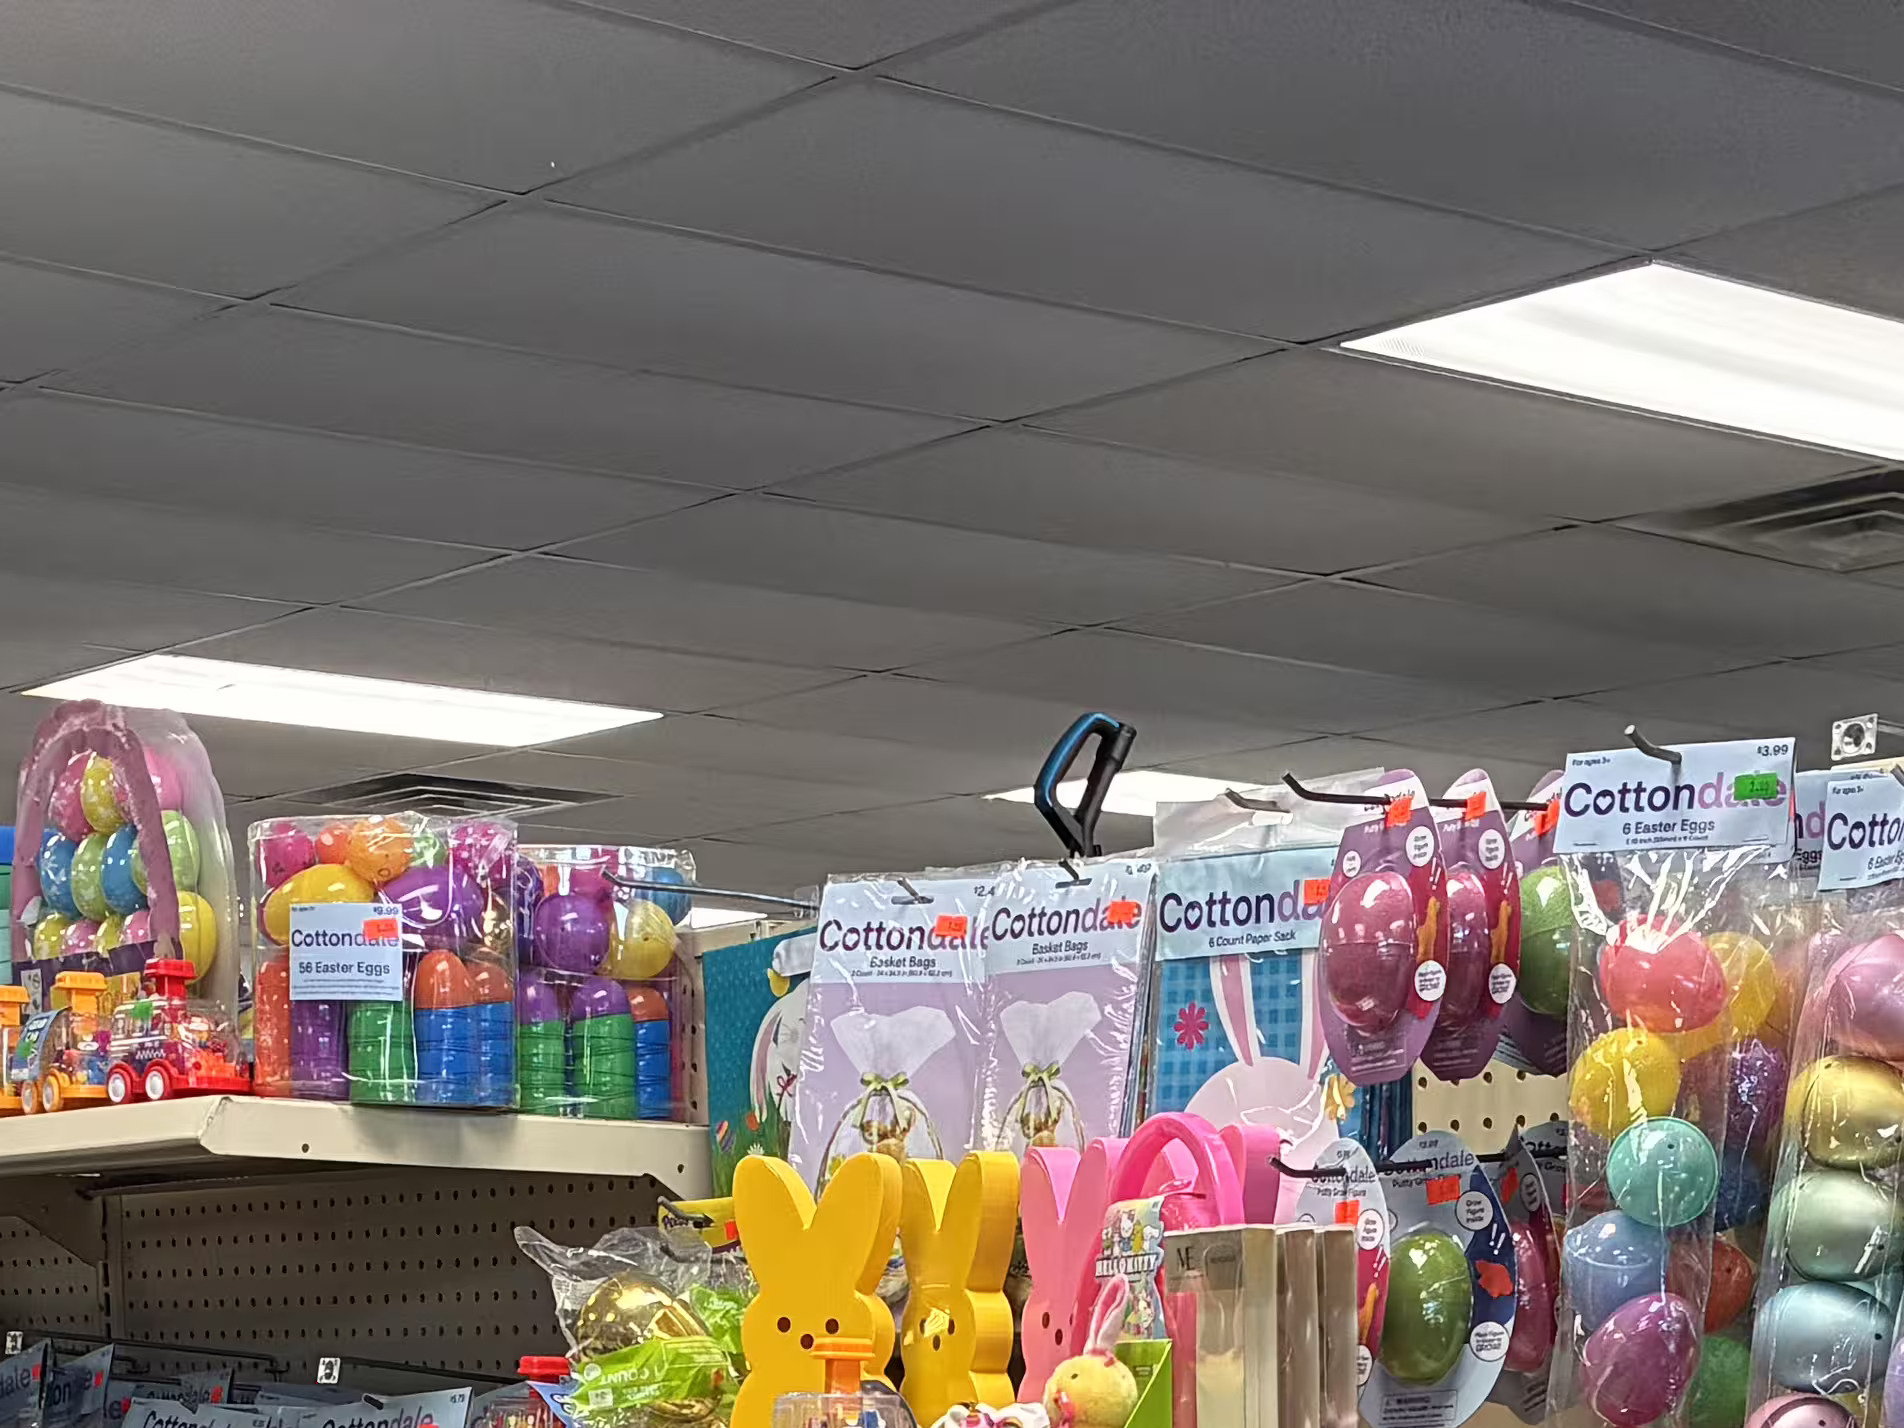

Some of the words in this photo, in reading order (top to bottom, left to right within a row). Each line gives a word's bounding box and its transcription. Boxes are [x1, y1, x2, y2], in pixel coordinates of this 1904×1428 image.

[1757, 744, 1788, 757] $3.99
[1623, 823, 1630, 834] 6
[1635, 821, 1676, 834] Easter
[1681, 819, 1715, 834] Eggs
[1216, 934, 1244, 946] Count
[1246, 933, 1272, 946] Paper
[1274, 929, 1296, 941] Sack
[1032, 942, 1062, 955] Basket
[1064, 941, 1088, 954] Bags
[299, 962, 312, 973] 56
[316, 962, 353, 973] Easter
[357, 962, 390, 976] Eggs
[870, 956, 906, 969] Basket
[910, 956, 936, 971] Bags
[600, 1368, 650, 1385] COUNT
